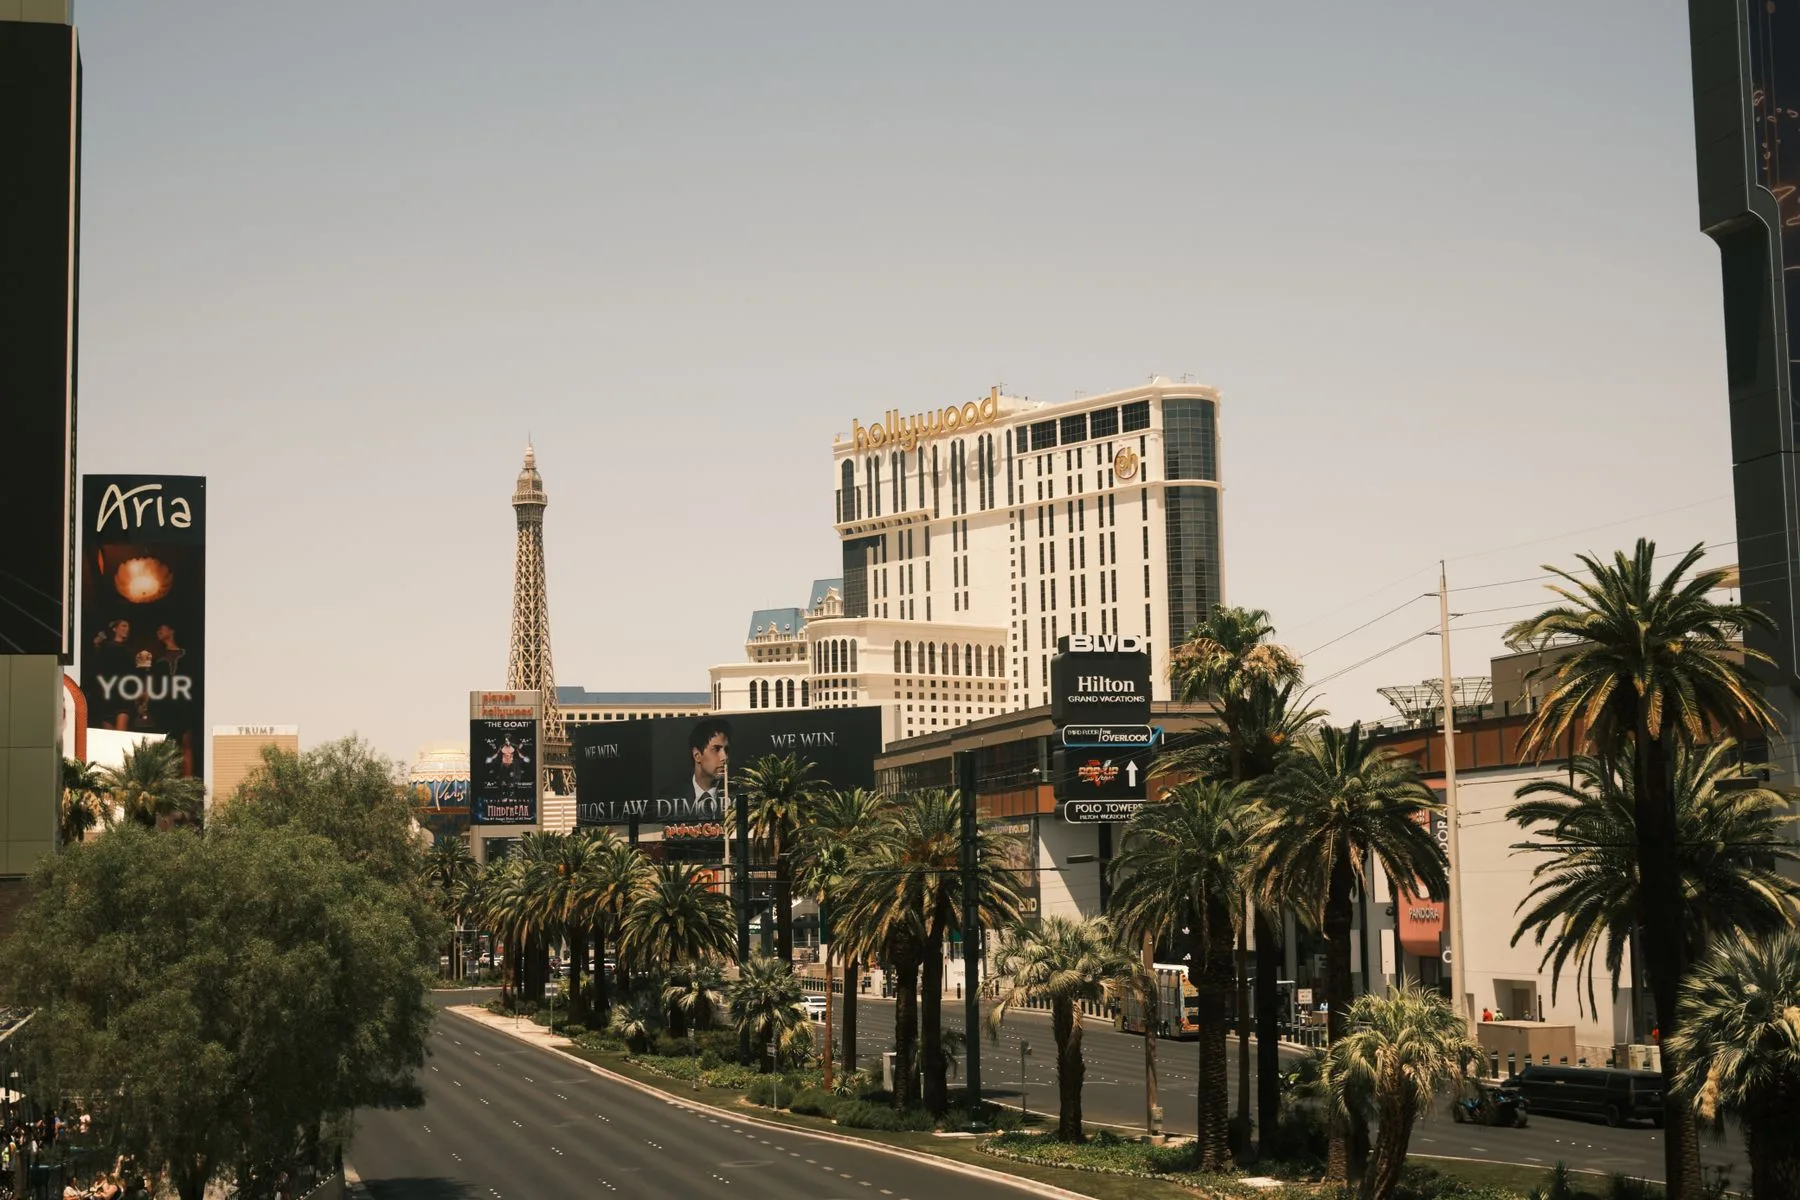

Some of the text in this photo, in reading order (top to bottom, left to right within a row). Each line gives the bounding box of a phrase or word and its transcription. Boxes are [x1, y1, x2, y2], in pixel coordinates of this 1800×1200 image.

[853, 386, 998, 452] hollywood
[97, 484, 191, 532] Aria
[1069, 635, 1141, 652] BLVD
[97, 675, 192, 700] YOUR
[1078, 676, 1135, 692] Hilton
[238, 727, 274, 735] TRUMP
[1102, 734, 1148, 742] OVERLOOK
[770, 734, 796, 749] WE
[585, 746, 596, 759] WE
[610, 799, 648, 820] LAW
[1075, 803, 1102, 813] POLO
[1409, 907, 1440, 920] PANDORA
